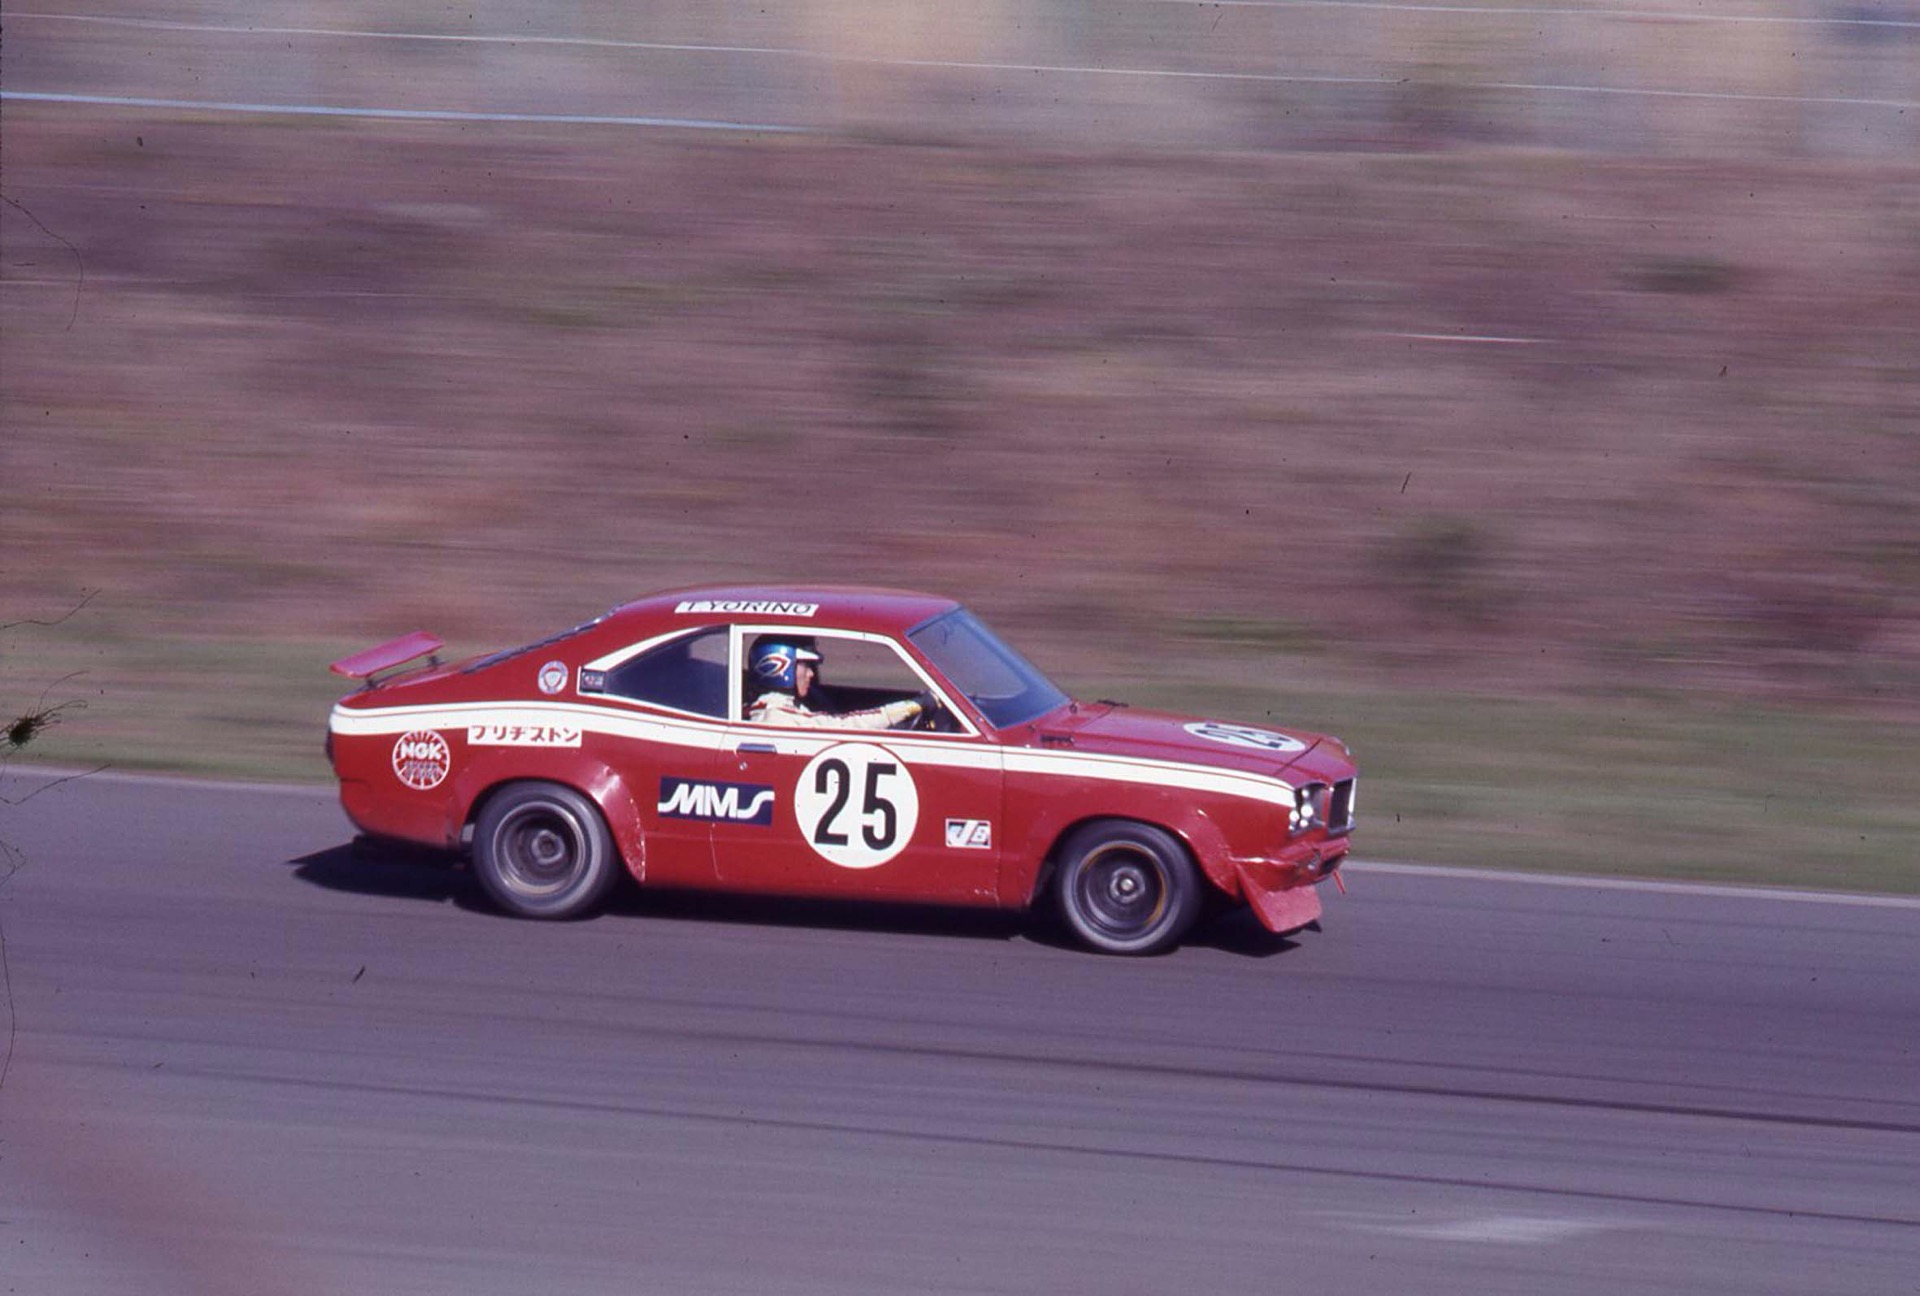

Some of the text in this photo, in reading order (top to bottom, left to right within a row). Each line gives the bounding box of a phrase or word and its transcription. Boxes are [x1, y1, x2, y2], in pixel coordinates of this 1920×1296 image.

[709, 601, 811, 615] YORINO
[400, 741, 443, 760] NGK
[656, 783, 775, 819] MMS
[813, 757, 897, 851] 25
